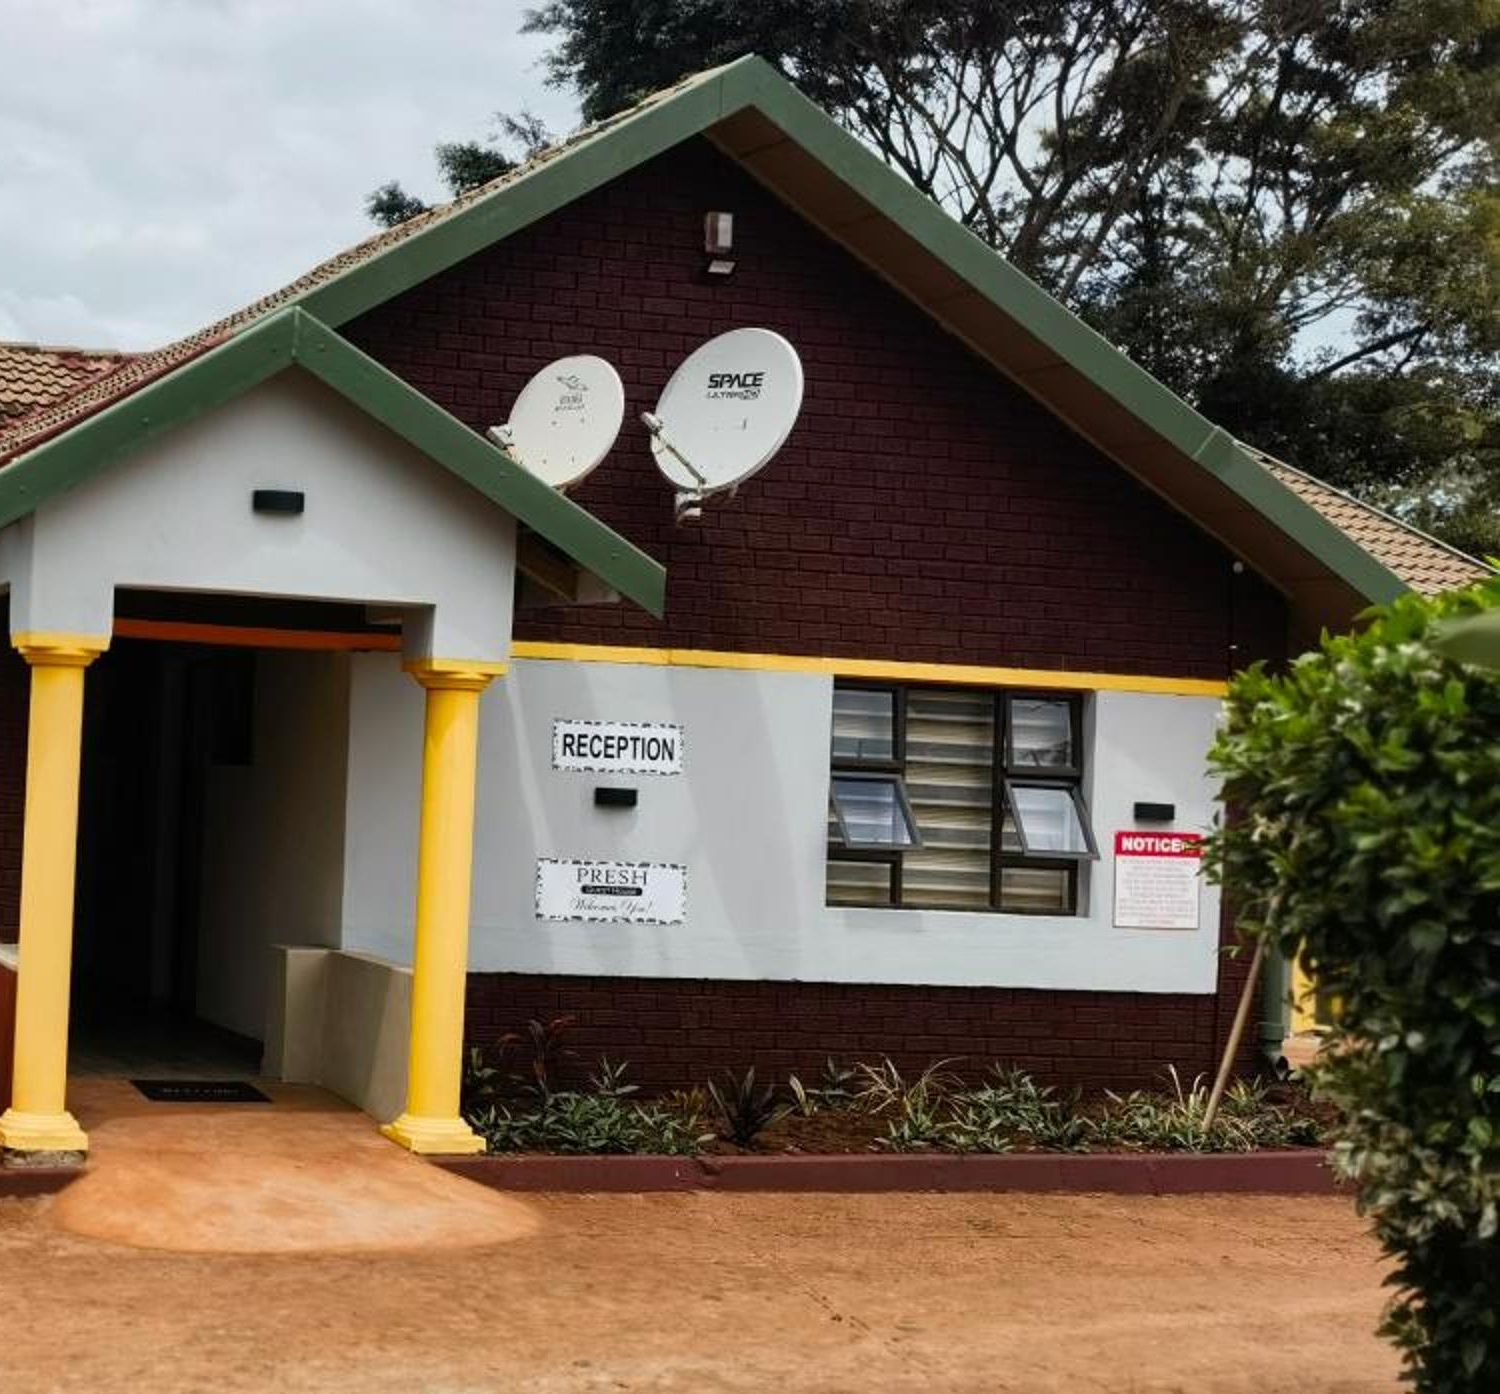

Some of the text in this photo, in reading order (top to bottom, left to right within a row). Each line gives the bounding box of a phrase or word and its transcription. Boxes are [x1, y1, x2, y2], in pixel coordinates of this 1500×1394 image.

[708, 372, 766, 388] SPACE
[562, 733, 675, 761] RECEPTION
[576, 867, 647, 885] PRESH
